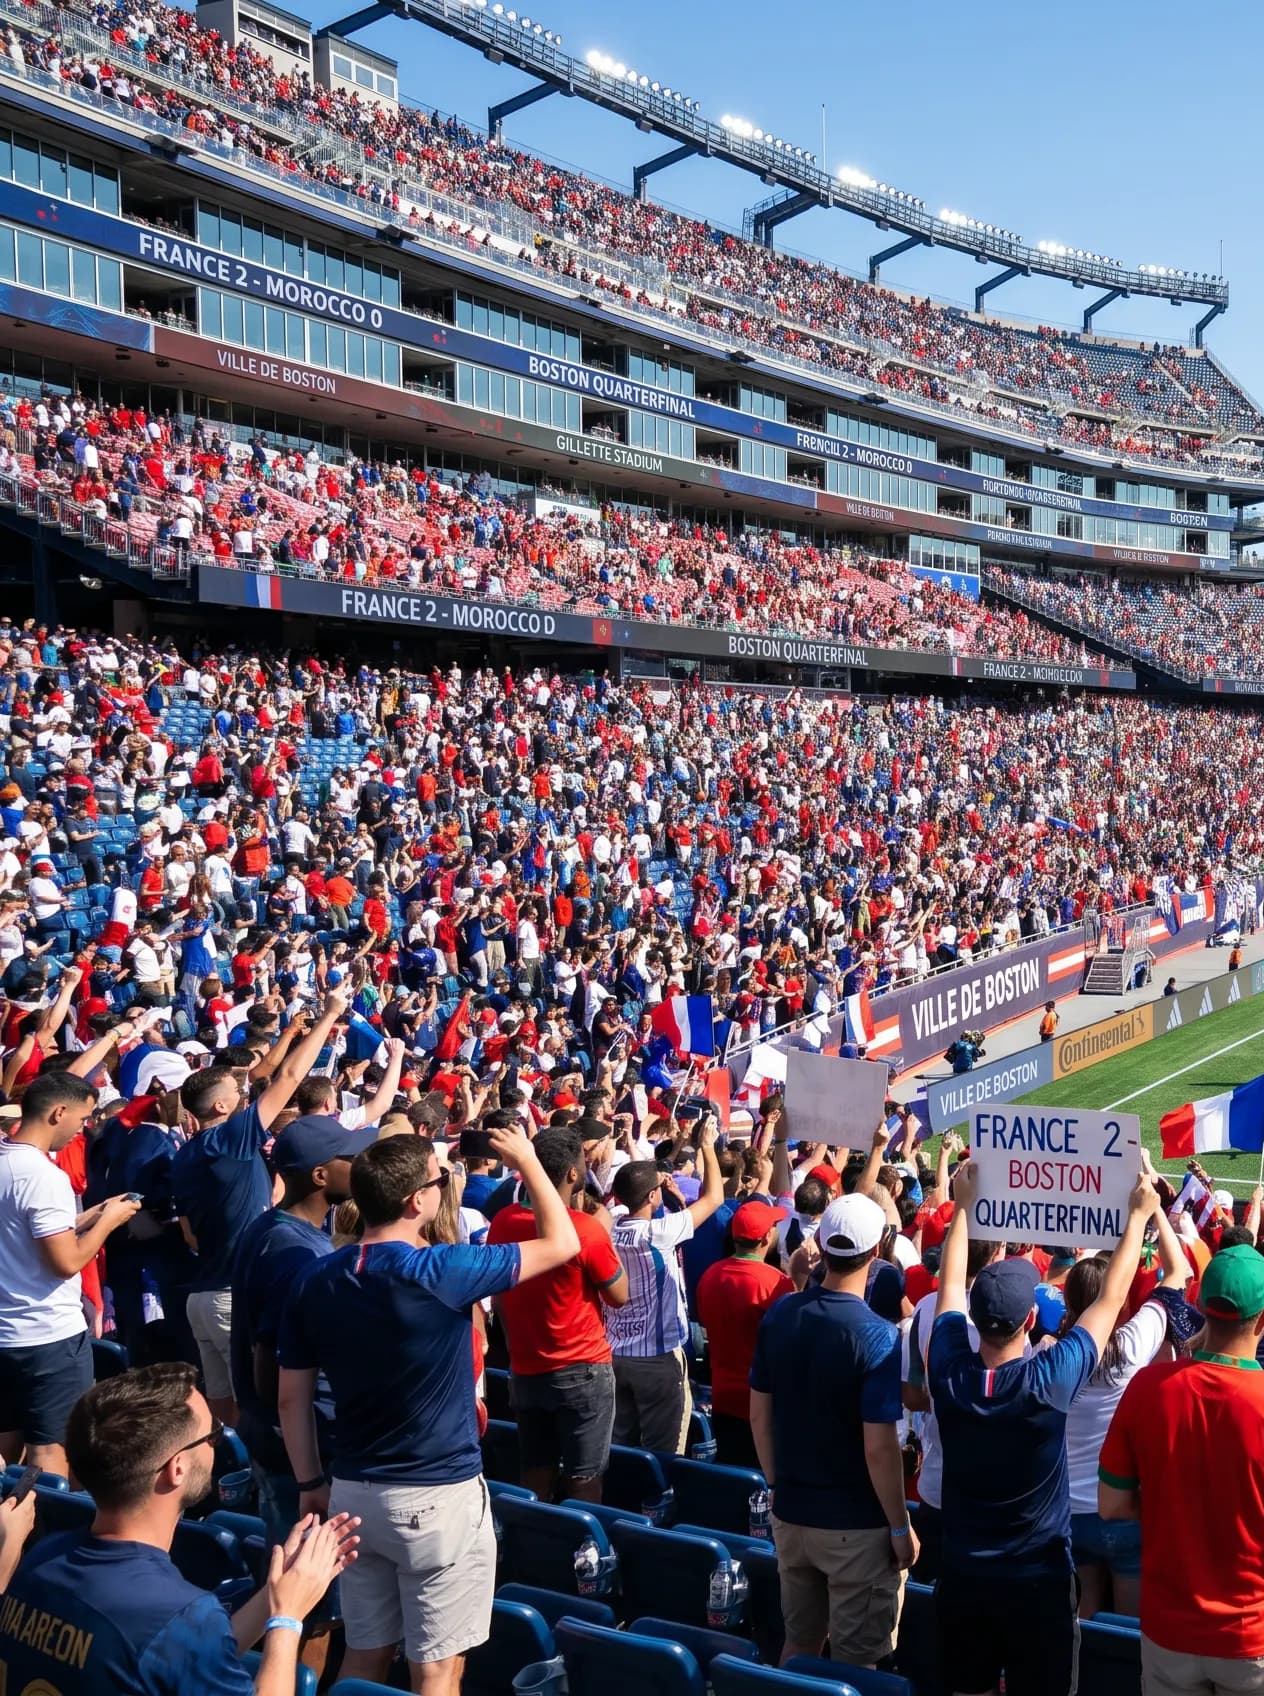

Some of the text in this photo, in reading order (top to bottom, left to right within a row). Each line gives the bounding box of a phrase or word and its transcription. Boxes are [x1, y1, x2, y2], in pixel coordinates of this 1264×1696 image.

[139, 232, 231, 282] FRANCE
[235, 264, 248, 287] 2
[266, 274, 366, 323] MOROCCO
[370, 308, 383, 329] 0
[216, 349, 336, 394] VILLE DE BOSTON
[529, 356, 696, 419] BOSTON QUARTERFINAL
[556, 435, 663, 473] GILLETTE STADIUM
[856, 447, 905, 472] MOROCCO
[342, 589, 421, 621] FRANCE
[425, 600, 437, 622] 2
[452, 603, 540, 634] MOROCCO
[728, 635, 869, 666] BOSTON QUARTERFINAL
[983, 662, 1018, 679] FRANCE
[1019, 665, 1026, 679] 2
[911, 957, 1040, 1040] VILLE DE BOSTON
[940, 1059, 1039, 1116] VILLE DE BOSTON
[975, 1113, 1079, 1154] FRANCE
[1103, 1121, 1122, 1157] 2
[1009, 1159, 1102, 1194] BOSTON
[975, 1198, 1123, 1238] QUARTERFINAL
